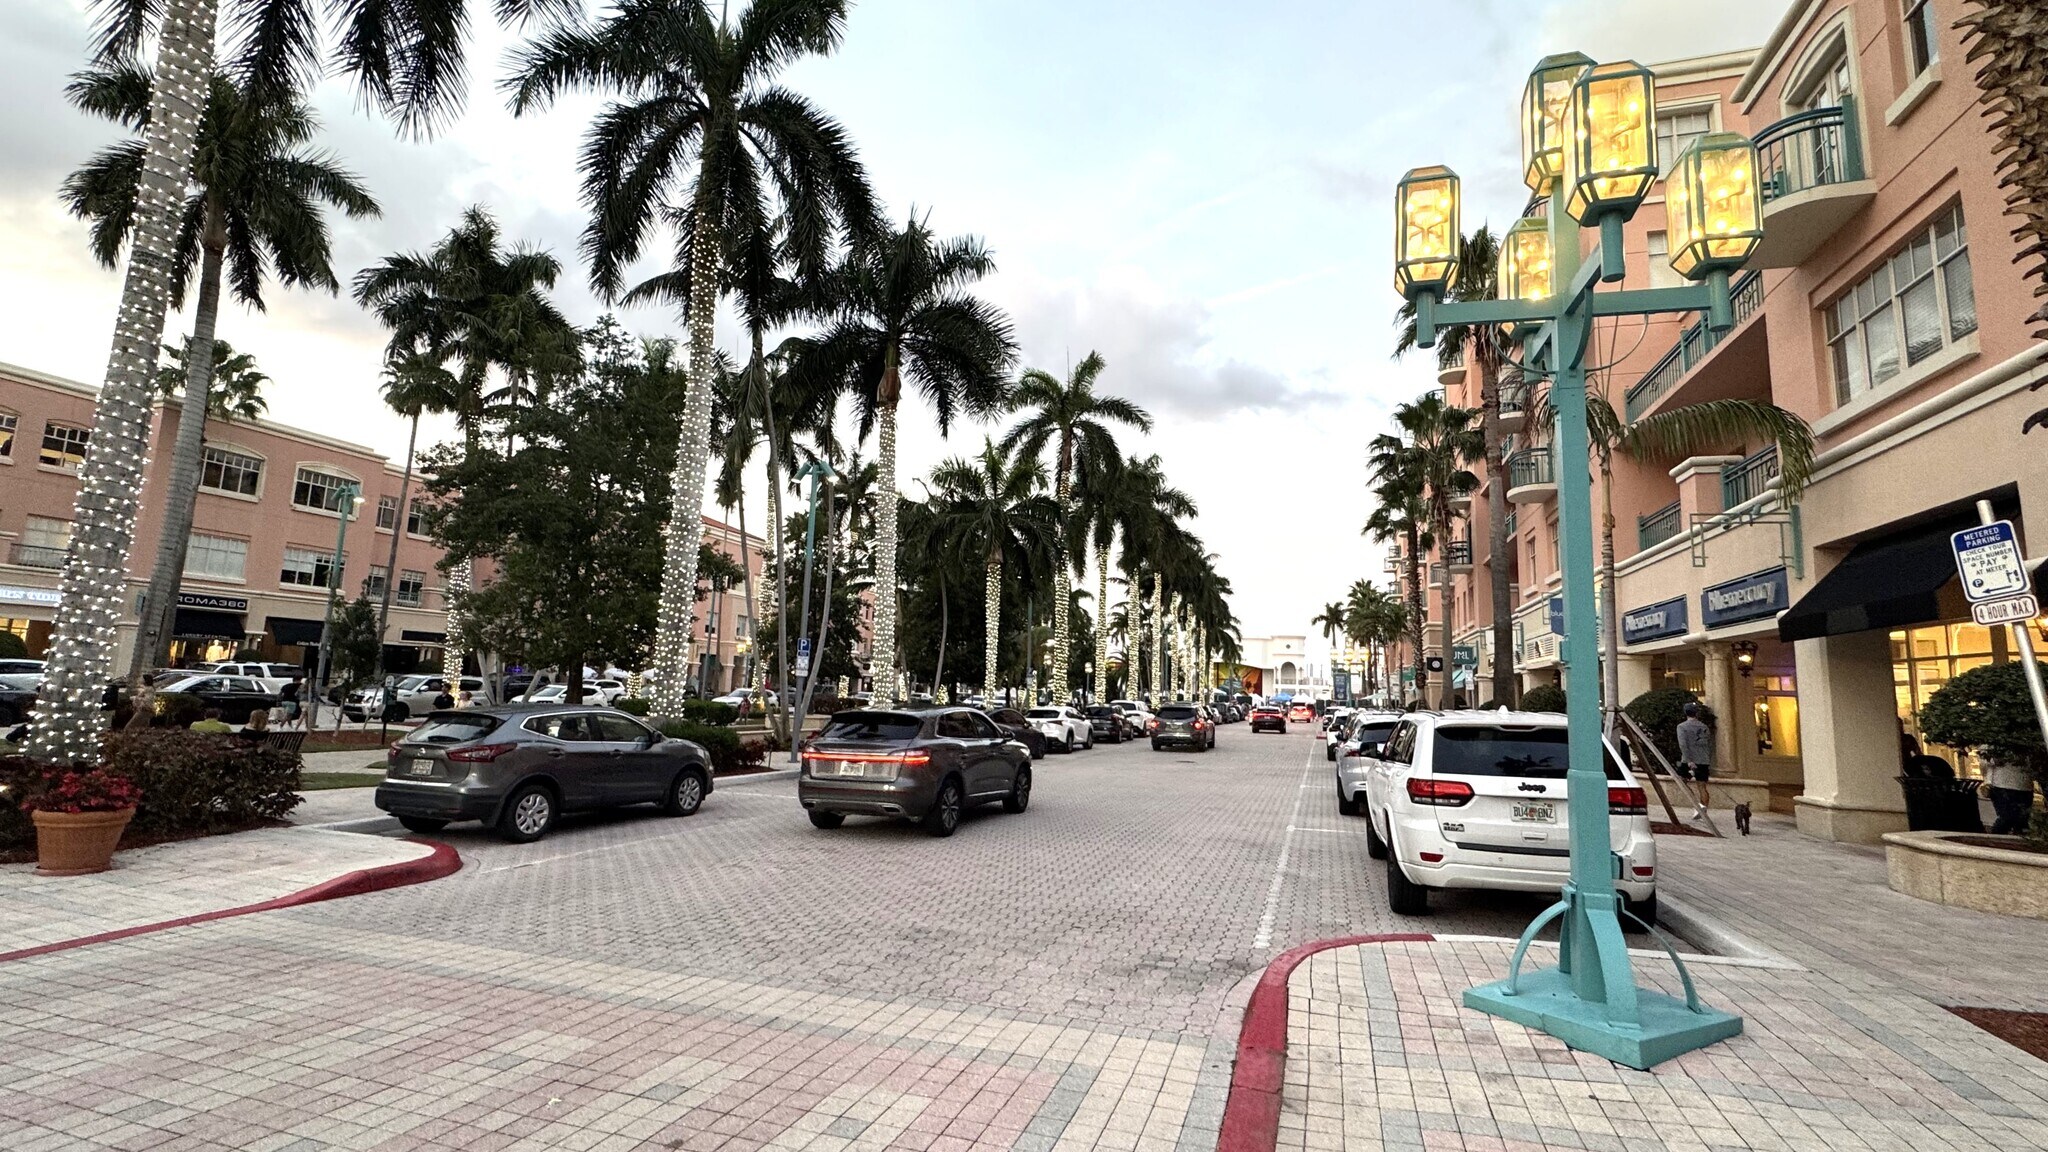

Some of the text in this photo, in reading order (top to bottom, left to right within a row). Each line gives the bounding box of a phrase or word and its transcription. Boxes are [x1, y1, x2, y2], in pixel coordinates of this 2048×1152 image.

[1963, 527, 1999, 541] METERED
[1965, 534, 2001, 548] PARKING
[1962, 547, 2012, 564] SPACE NUMBER
[1965, 542, 2006, 556] CHECK YOUR
[1979, 557, 1997, 568] PAY
[1985, 564, 2007, 573] METER
[1979, 607, 1986, 620] 4
[1986, 604, 2009, 620] HOUR
[800, 640, 808, 650] P
[1517, 782, 1547, 793] Jeep
